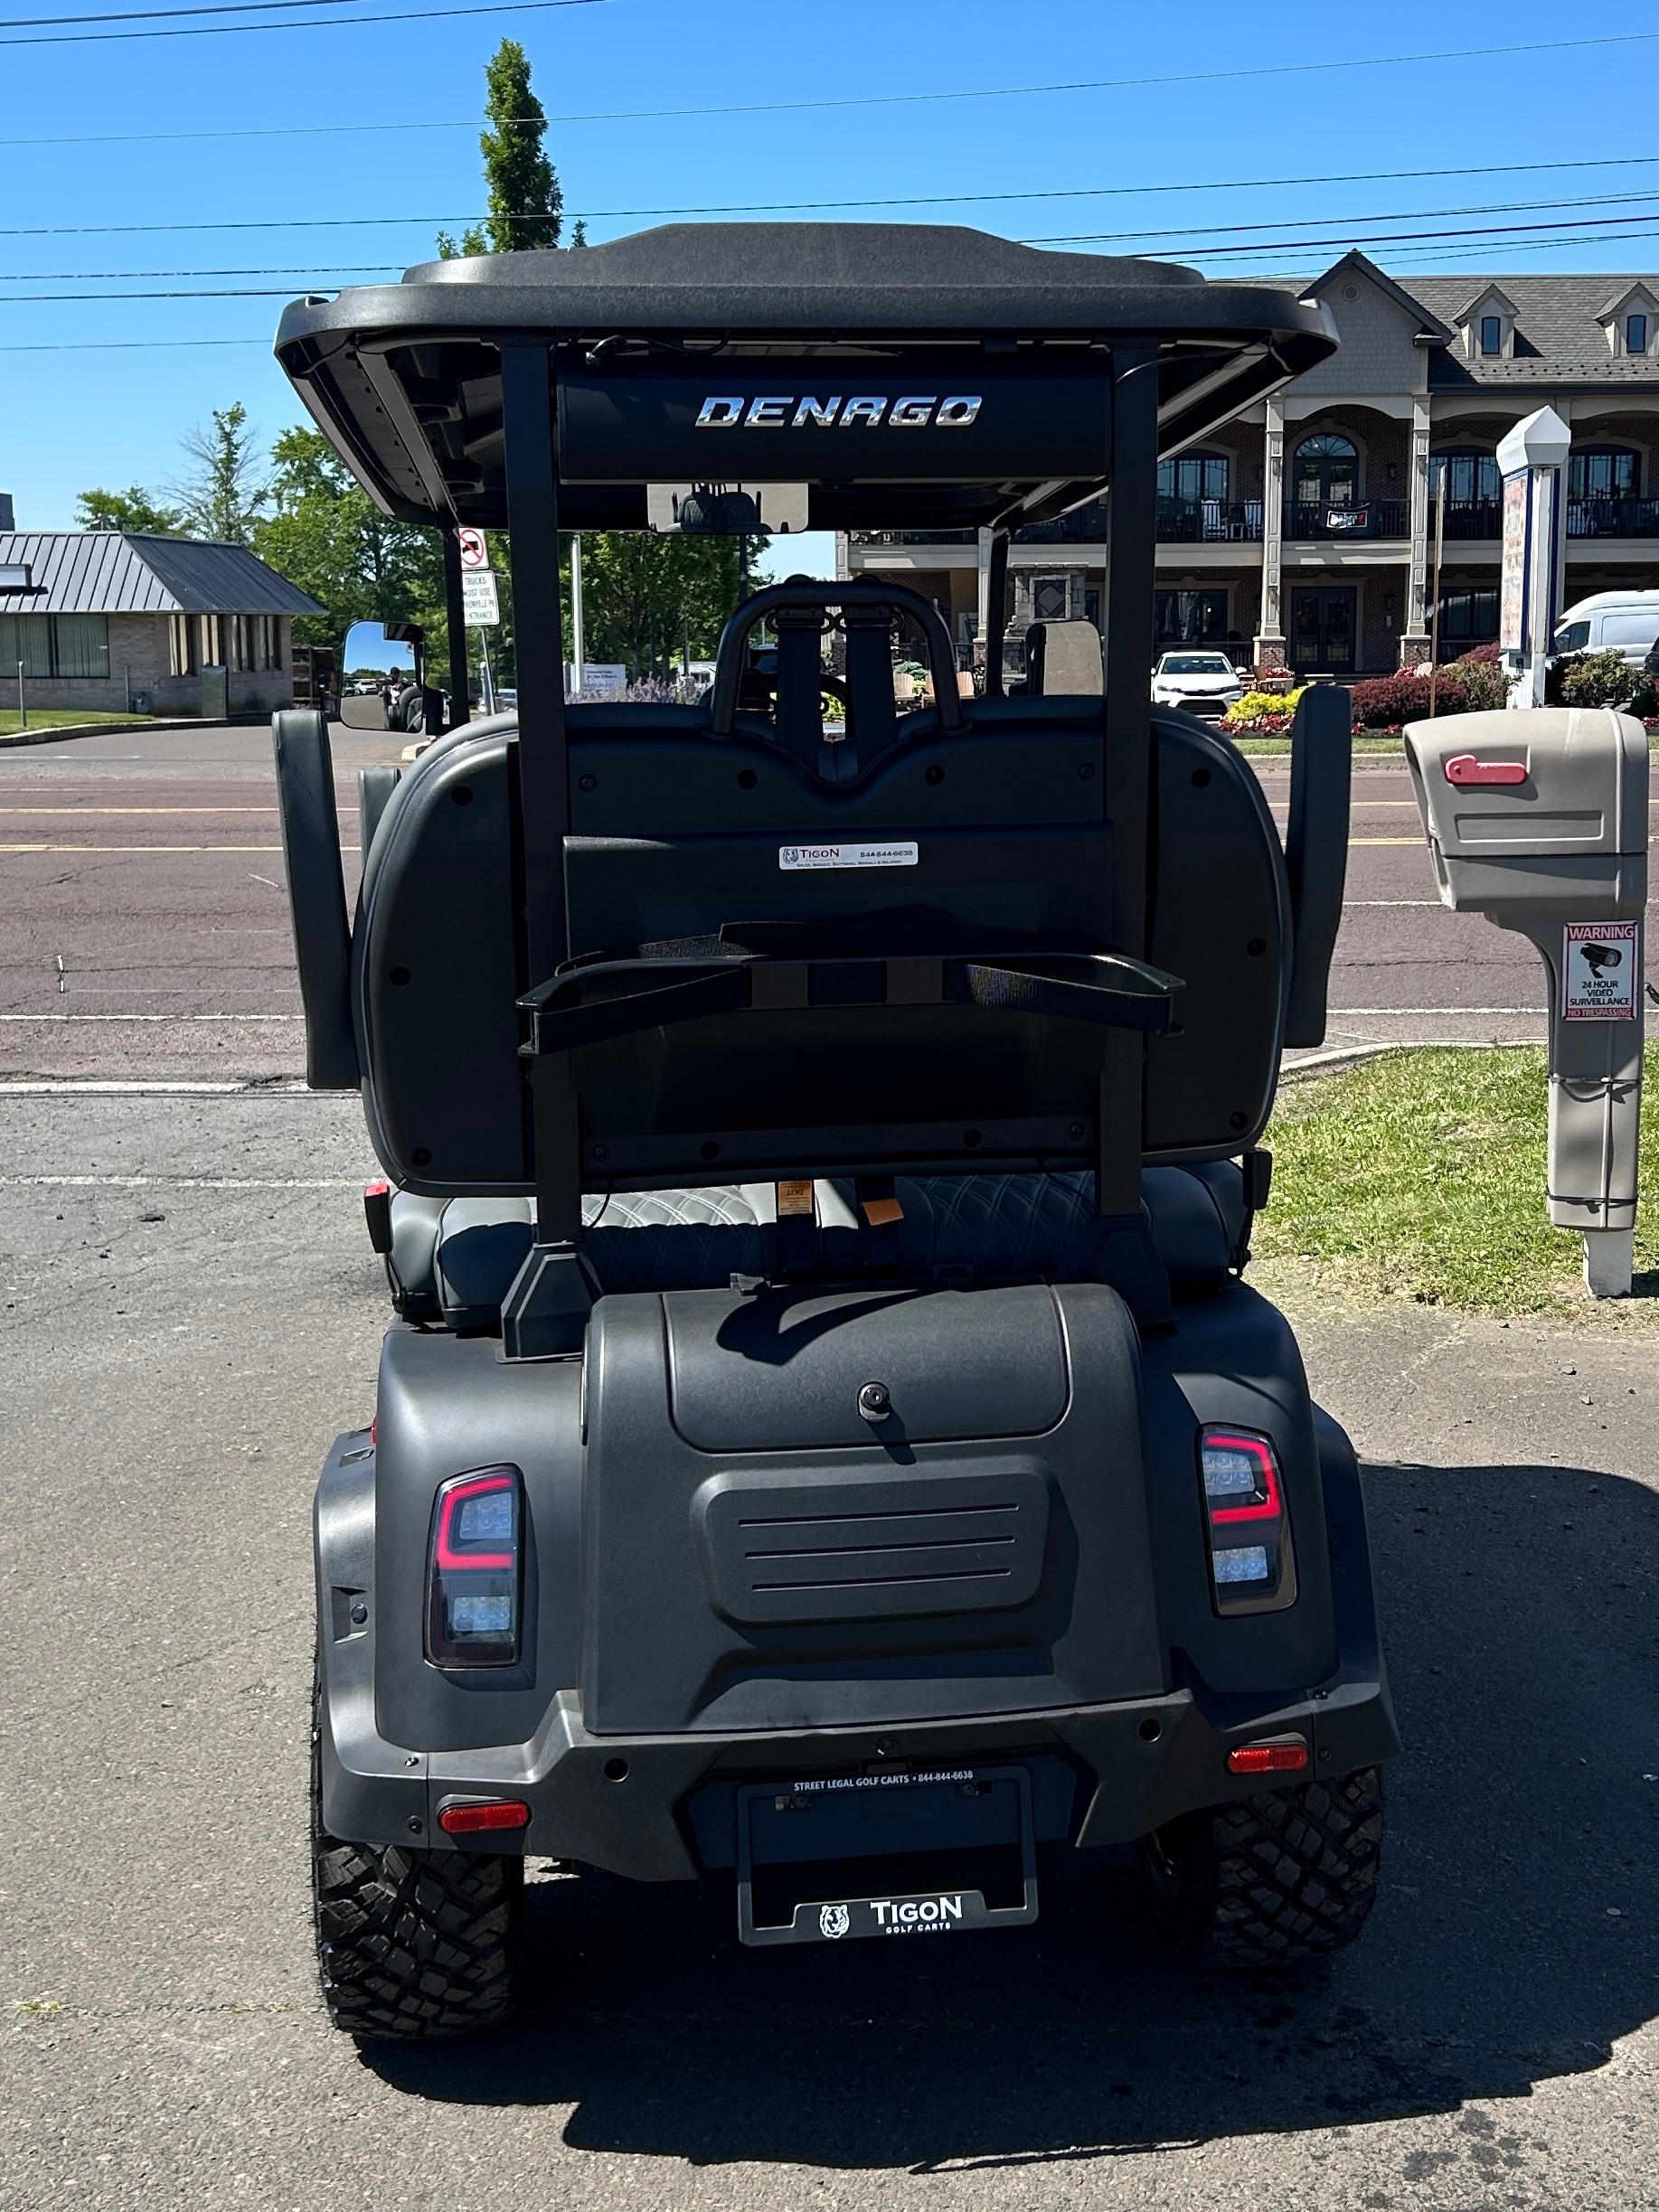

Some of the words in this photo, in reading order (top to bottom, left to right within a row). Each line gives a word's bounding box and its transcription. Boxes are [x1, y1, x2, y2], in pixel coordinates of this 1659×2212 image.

[694, 396, 983, 428] DENAGO
[465, 577, 486, 585] TRUCKS
[799, 848, 839, 859] TIGON
[1569, 925, 1635, 940] WARNING
[1581, 981, 1592, 989] 24
[1593, 980, 1619, 989] HOUR
[1587, 988, 1614, 997] VIDEO
[1569, 997, 1631, 1006] SURVEILLANCE
[1568, 1009, 1580, 1017] NO
[1582, 1008, 1632, 1017] TRESPASSING
[794, 1780, 825, 1792] STREET
[827, 1778, 854, 1789] LEGAL
[855, 1776, 880, 1787] GOLF
[881, 1774, 910, 1785] CARTS
[870, 1896, 962, 1925] TIGON
[885, 1925, 913, 1934] GOLF
[917, 1922, 951, 1932] CARTS
